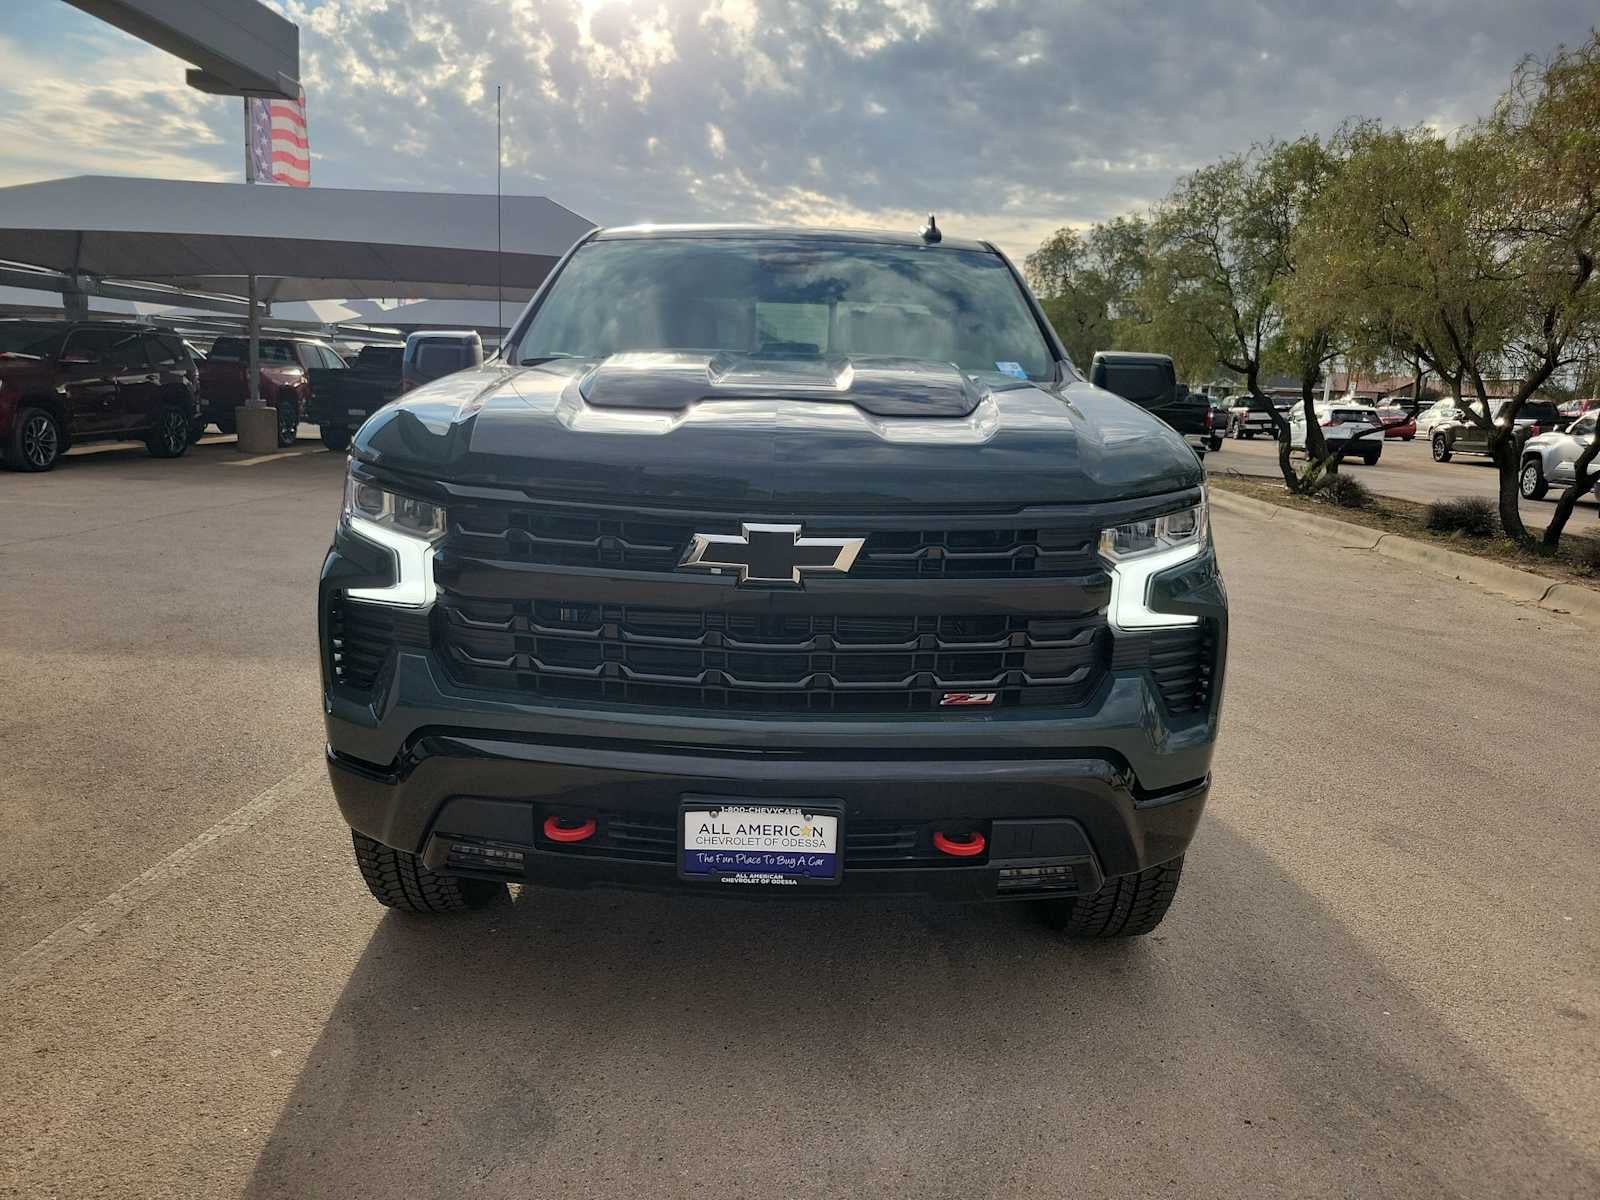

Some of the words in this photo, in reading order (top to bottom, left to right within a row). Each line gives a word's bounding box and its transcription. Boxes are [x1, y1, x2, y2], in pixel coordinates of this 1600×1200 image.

[699, 823, 730, 835] ALL
[695, 836, 761, 846] CHEVROLET
[764, 838, 779, 847] OF
[782, 838, 826, 848] ODESSA
[696, 852, 715, 864] The
[716, 853, 733, 863] Fun
[735, 853, 761, 865] Place
[762, 854, 775, 865] To
[797, 856, 806, 866] A
[808, 856, 825, 866] Car
